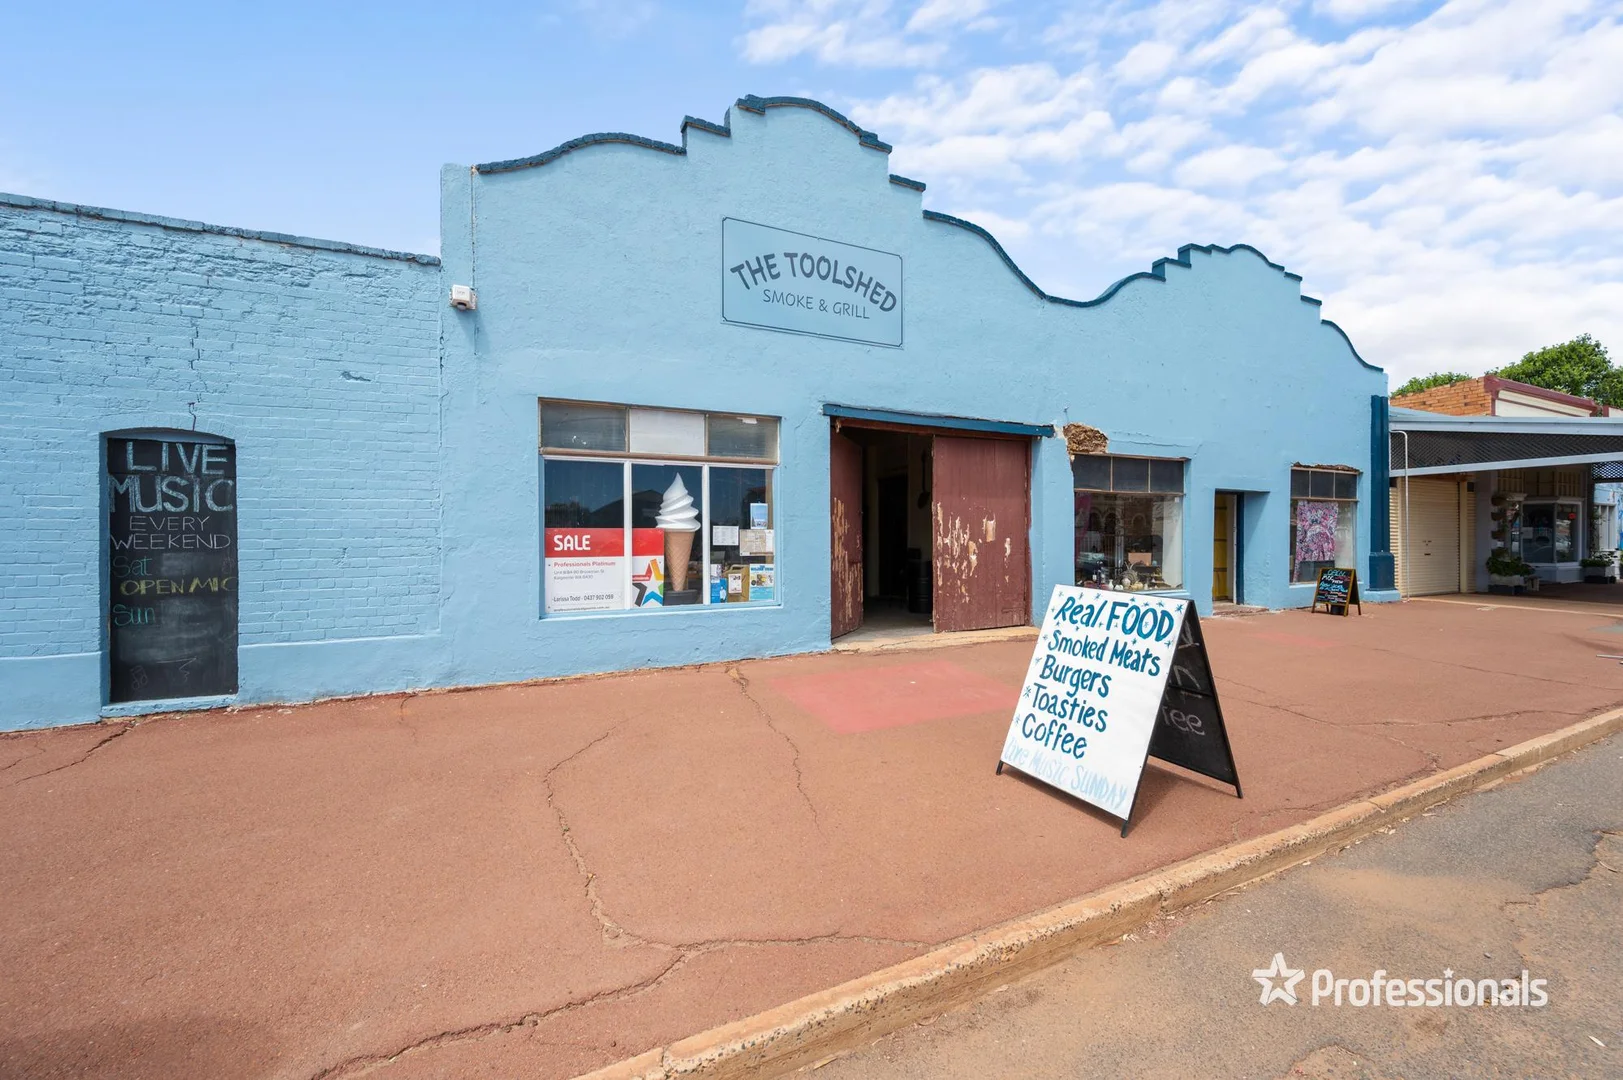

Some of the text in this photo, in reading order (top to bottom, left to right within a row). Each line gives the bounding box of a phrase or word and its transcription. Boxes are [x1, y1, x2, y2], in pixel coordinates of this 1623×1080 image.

[730, 252, 897, 312] THE TOOLSHED
[763, 289, 870, 319] SMOKE & GRILL
[126, 441, 228, 475] LIVE
[108, 474, 234, 513] MUSIC
[129, 515, 210, 531] EVERY
[111, 533, 231, 550] WEEKEND
[553, 534, 591, 551] SALE
[113, 556, 152, 577] Sat
[120, 576, 237, 596] OPEN MIC
[113, 604, 156, 626] Sun
[1054, 597, 1108, 628] Real
[1106, 601, 1174, 642] FOOD
[1048, 629, 1161, 677] Smoked Meats
[1039, 654, 1112, 698] Burgers
[1032, 682, 1109, 733] Toasties
[1022, 713, 1087, 759] Coffee
[1071, 764, 1128, 810] SUNDAY
